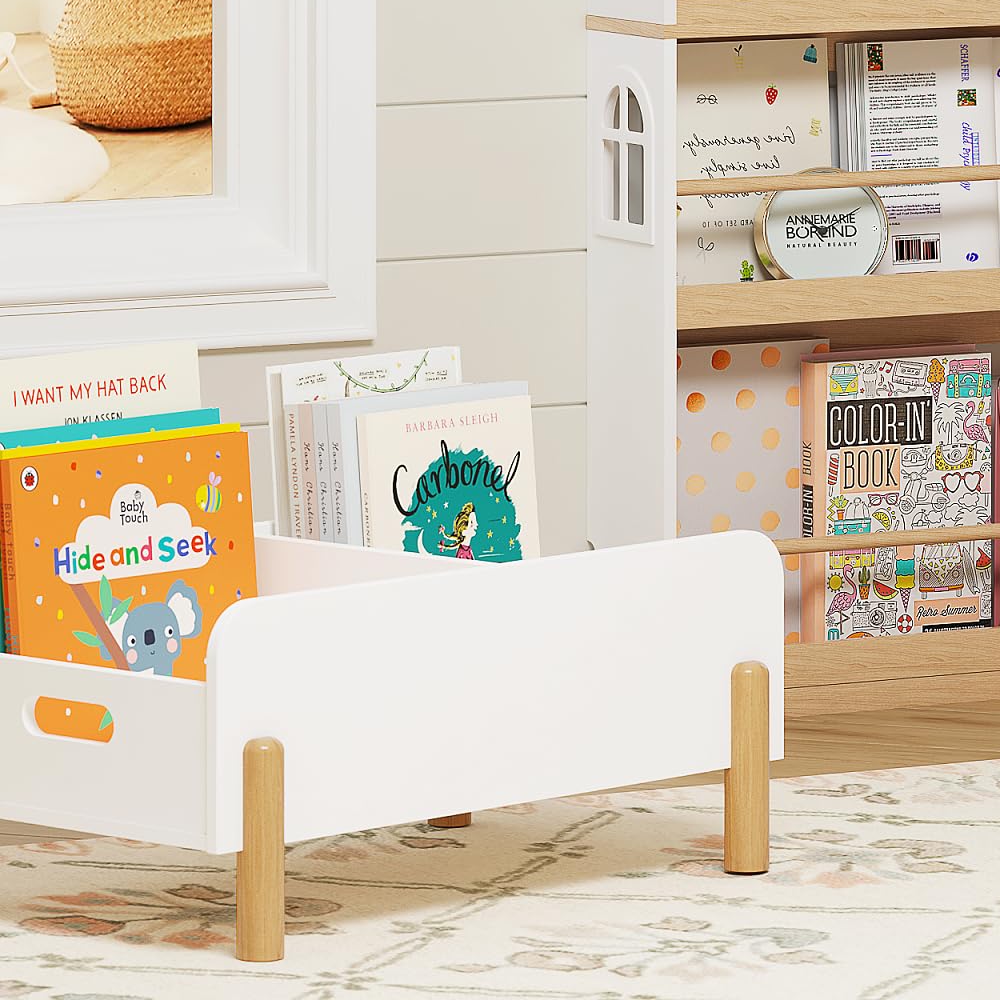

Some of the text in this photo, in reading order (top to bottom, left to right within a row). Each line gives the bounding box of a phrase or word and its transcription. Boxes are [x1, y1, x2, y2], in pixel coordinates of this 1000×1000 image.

[960, 43, 969, 82] SCHAFFER
[786, 214, 856, 225] ANNEMARIE
[13, 373, 167, 407] I WANT MY HAT BACK
[288, 413, 297, 453] PAMELA
[405, 412, 499, 433] BARBARA SLEIGH
[803, 441, 812, 476] BOOK
[844, 449, 898, 489] BOOK
[291, 457, 299, 498] LYNDON
[392, 440, 521, 516] Carbonel
[120, 500, 145, 514] Baby
[120, 512, 148, 525] Touch
[54, 531, 217, 576] Hide and Seek
[916, 604, 977, 621] Retro Summer
